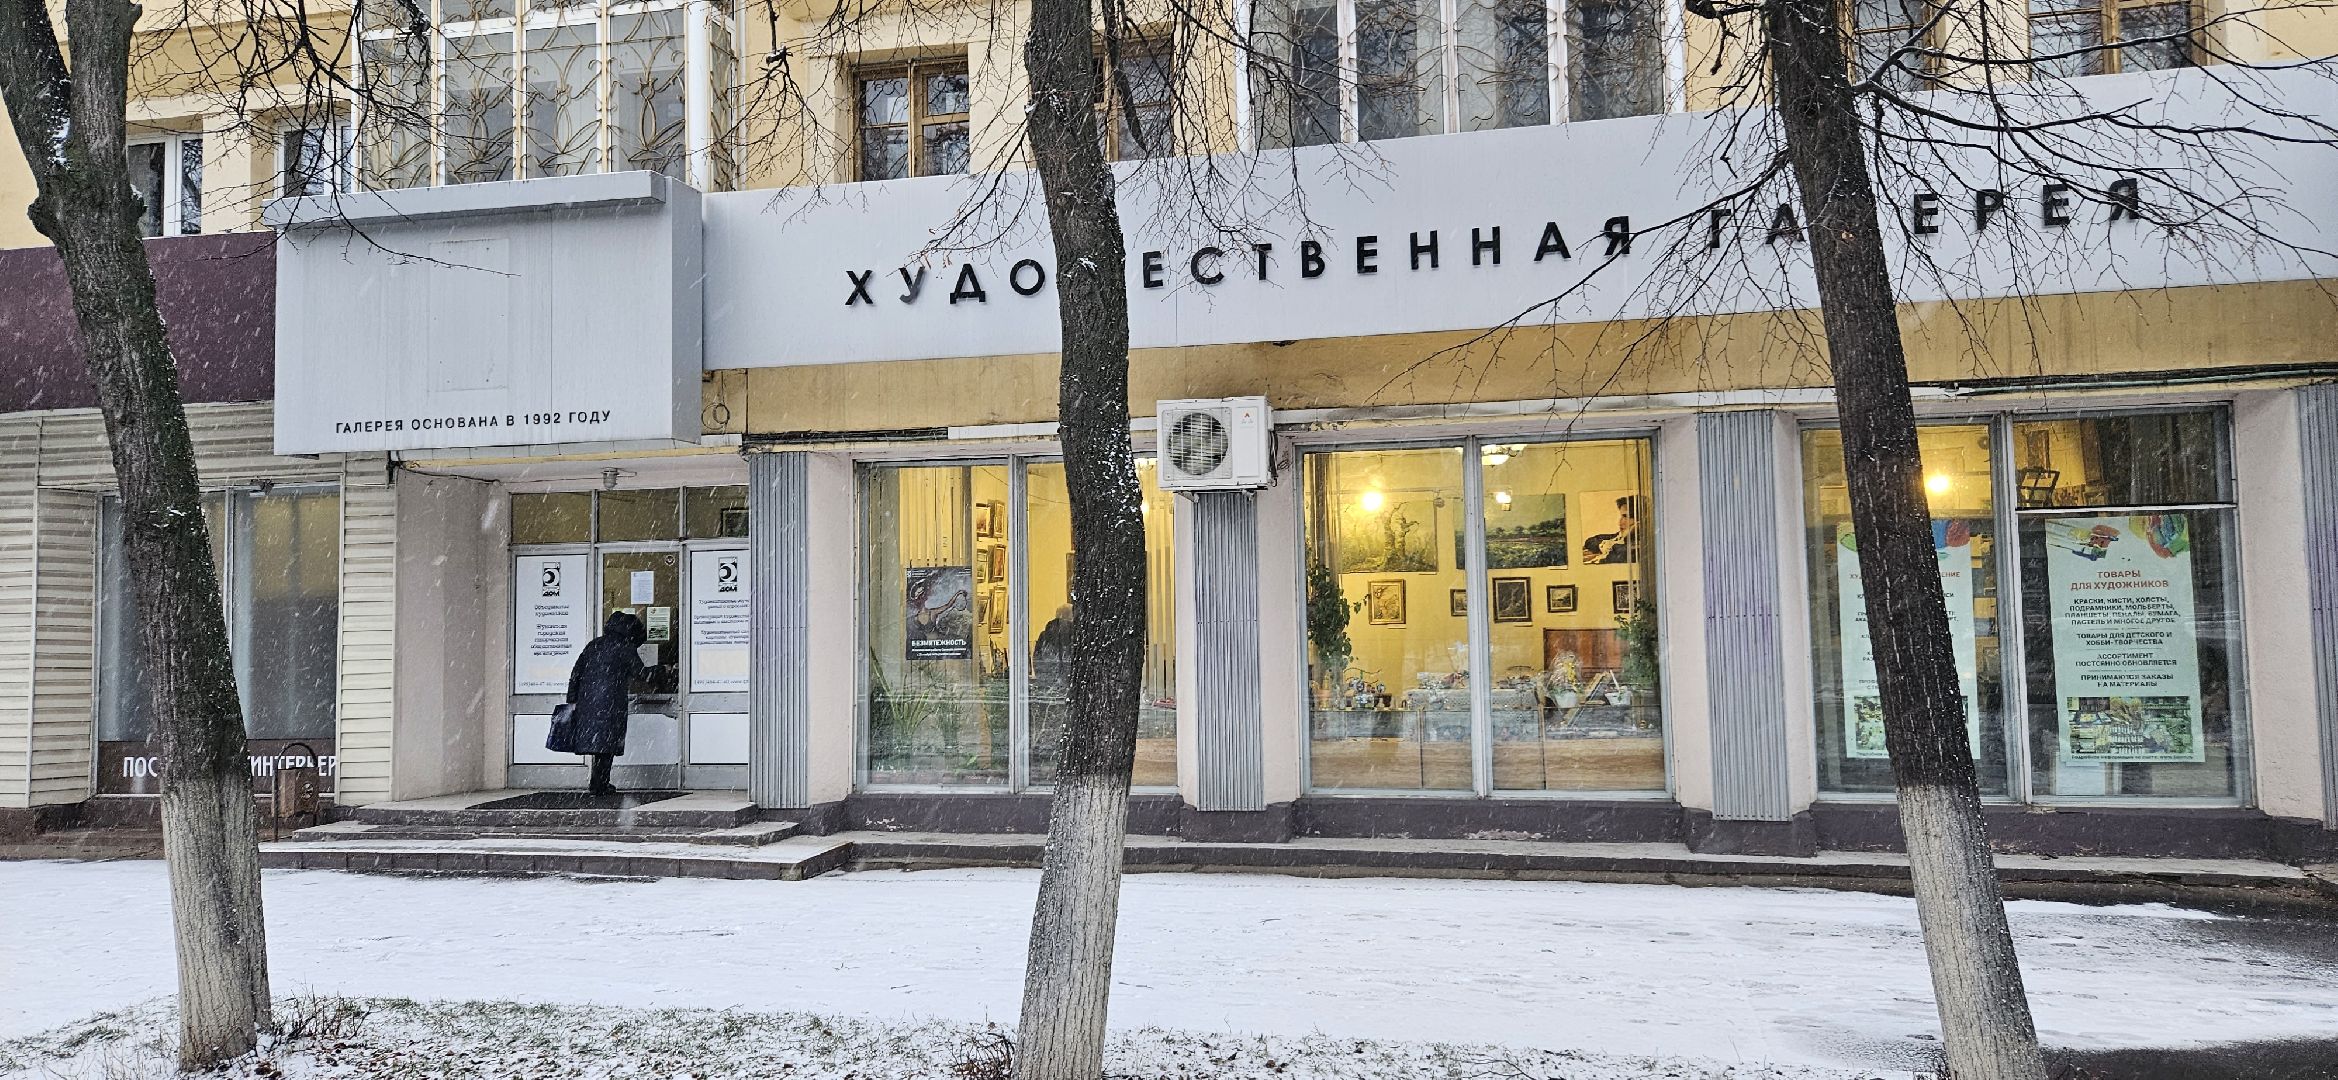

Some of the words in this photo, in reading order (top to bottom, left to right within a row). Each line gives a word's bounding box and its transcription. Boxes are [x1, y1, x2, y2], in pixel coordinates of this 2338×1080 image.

[844, 215, 1632, 305] ХУДОЕСТВЕННАЯ
[1710, 177, 2139, 249] ГАЕРЕЯ
[335, 419, 403, 434] ГАЛЕРЕЯ
[411, 415, 498, 431] ОСНОВАНА
[506, 415, 515, 426] В
[524, 412, 561, 425] 1992
[569, 410, 611, 425] ГОДУ
[2097, 570, 2141, 578] ТОВАРЫ
[2070, 582, 2092, 591] ДЛЯ
[2094, 580, 2169, 590] ХУДОЖНИКОВ
[2125, 631, 2165, 639] ДЕТСКОГО
[2096, 652, 2154, 660] АССОРТИМЕНТ
[122, 756, 158, 778] ПОС
